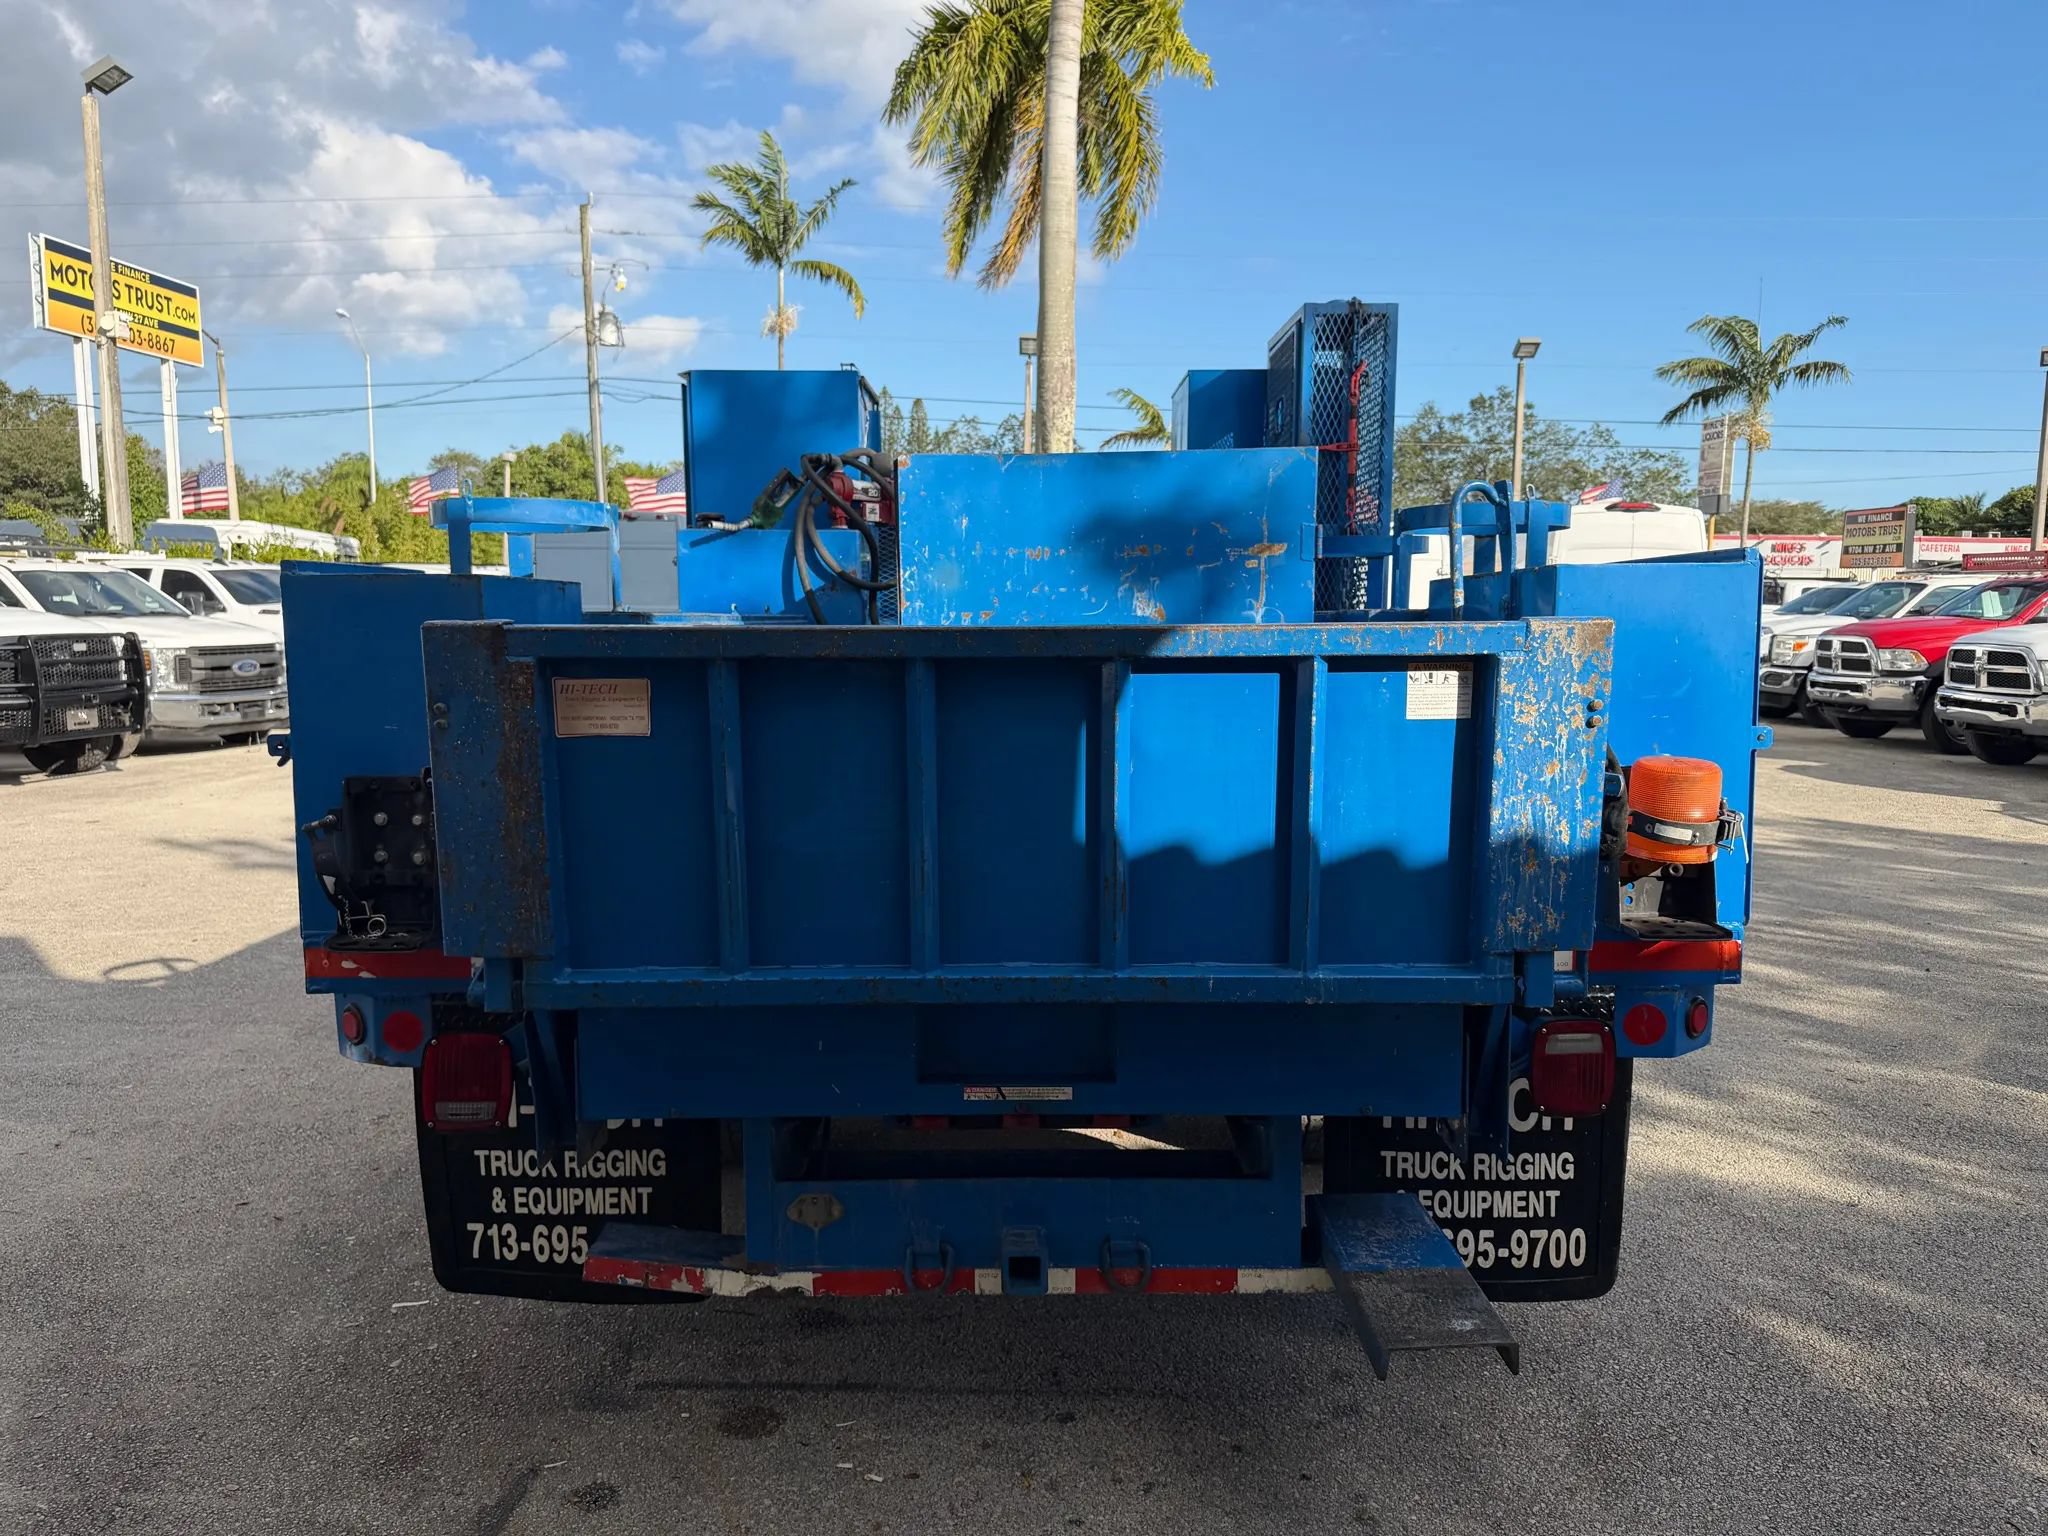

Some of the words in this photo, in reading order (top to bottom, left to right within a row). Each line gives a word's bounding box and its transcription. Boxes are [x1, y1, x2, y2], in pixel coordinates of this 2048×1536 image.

[50, 258, 121, 301] MOTS
[118, 264, 151, 283] FINANCE
[144, 316, 159, 329] AVE
[122, 326, 176, 355] 03-8867
[868, 488, 878, 497] 20
[1857, 515, 1866, 523] WE
[1867, 512, 1893, 523] FINANCE
[1845, 527, 1877, 538] MOTORS
[1878, 525, 1903, 537] TRUST
[1863, 545, 1875, 553] NW
[1885, 544, 1897, 553] AVE
[1920, 544, 1961, 553] CAFETERIA
[560, 683, 619, 695] HI-TECH
[1380, 1150, 1466, 1180] TRUCK
[1473, 1151, 1575, 1181] RIGGING
[492, 1187, 507, 1214] &
[514, 1187, 652, 1215] EQUIPMENT
[1418, 1190, 1561, 1219] EQUIPMENT
[466, 1222, 589, 1265] 713-695
[1441, 1227, 1587, 1269] 95-9700
